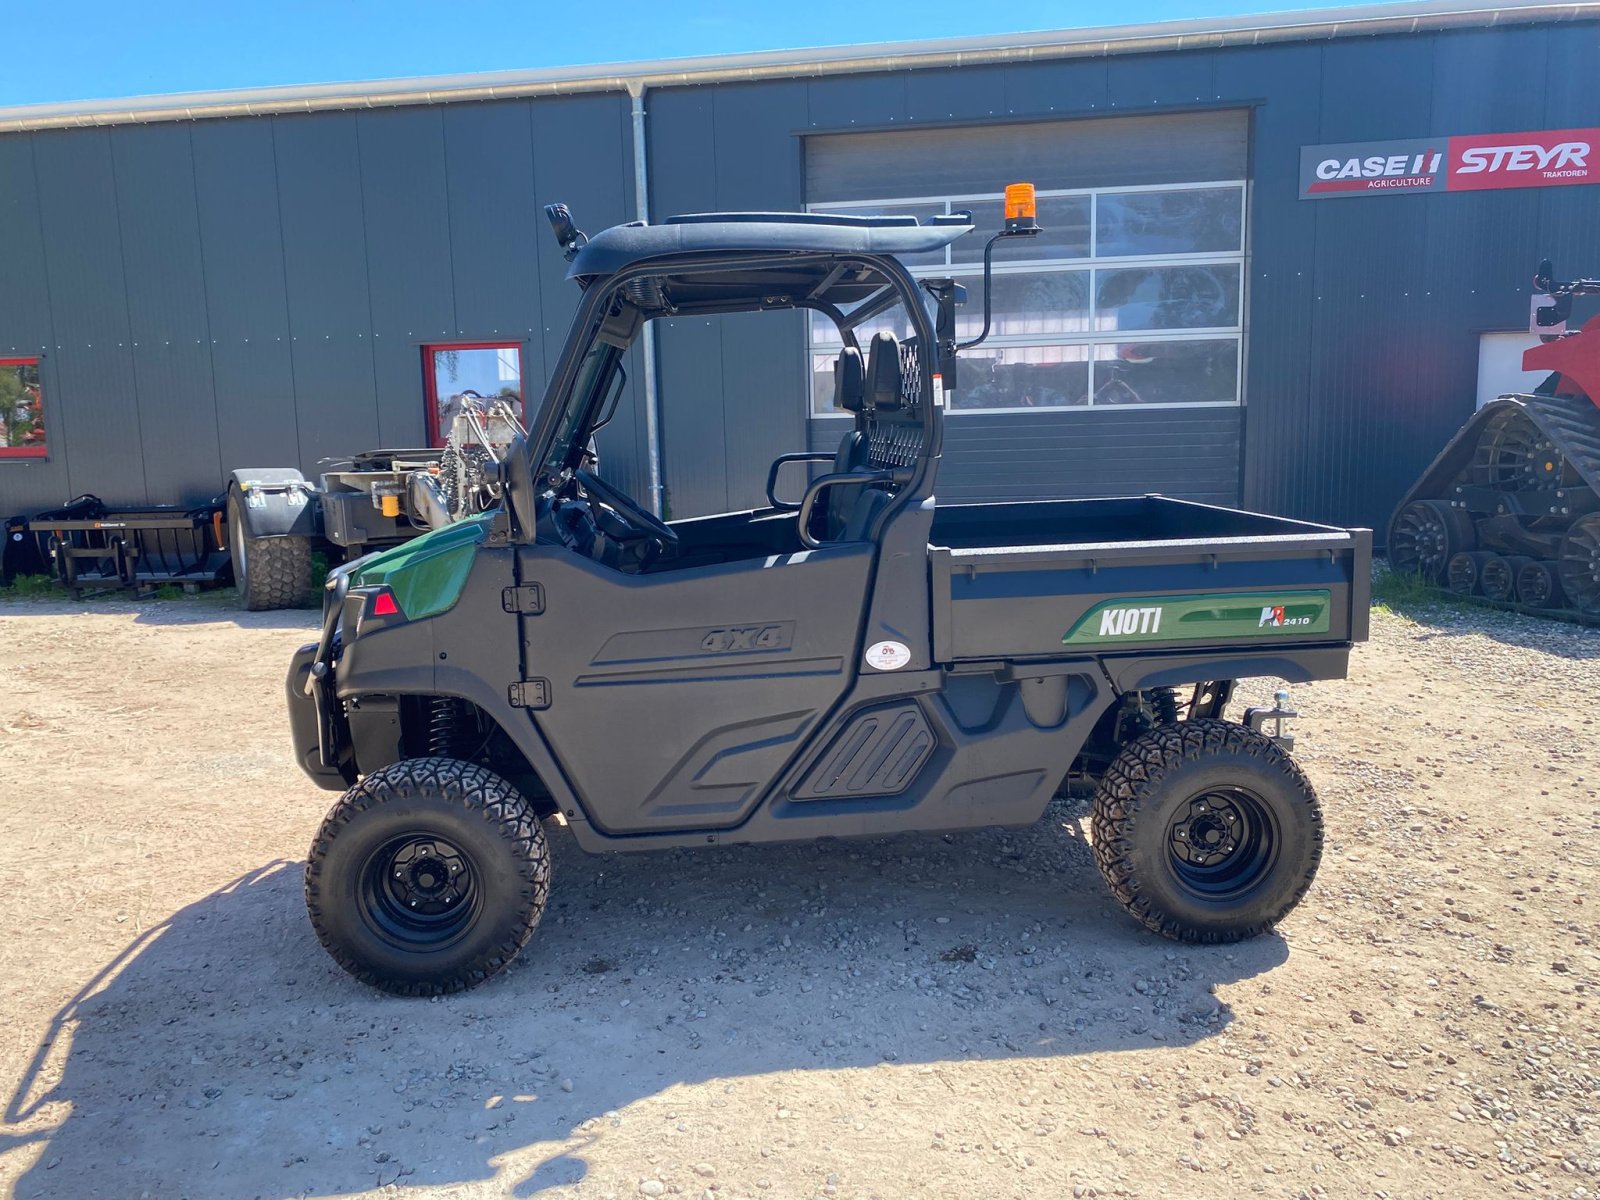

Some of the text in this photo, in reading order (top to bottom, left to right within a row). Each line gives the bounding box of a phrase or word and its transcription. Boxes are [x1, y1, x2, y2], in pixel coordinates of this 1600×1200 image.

[1456, 142, 1590, 174] STEYR
[1316, 155, 1408, 180] CASE
[1542, 170, 1587, 178] TRAKTOREN
[1367, 177, 1431, 188] AGRICULTURE
[1099, 607, 1162, 636] KIOTI
[1283, 617, 1310, 626] 2410
